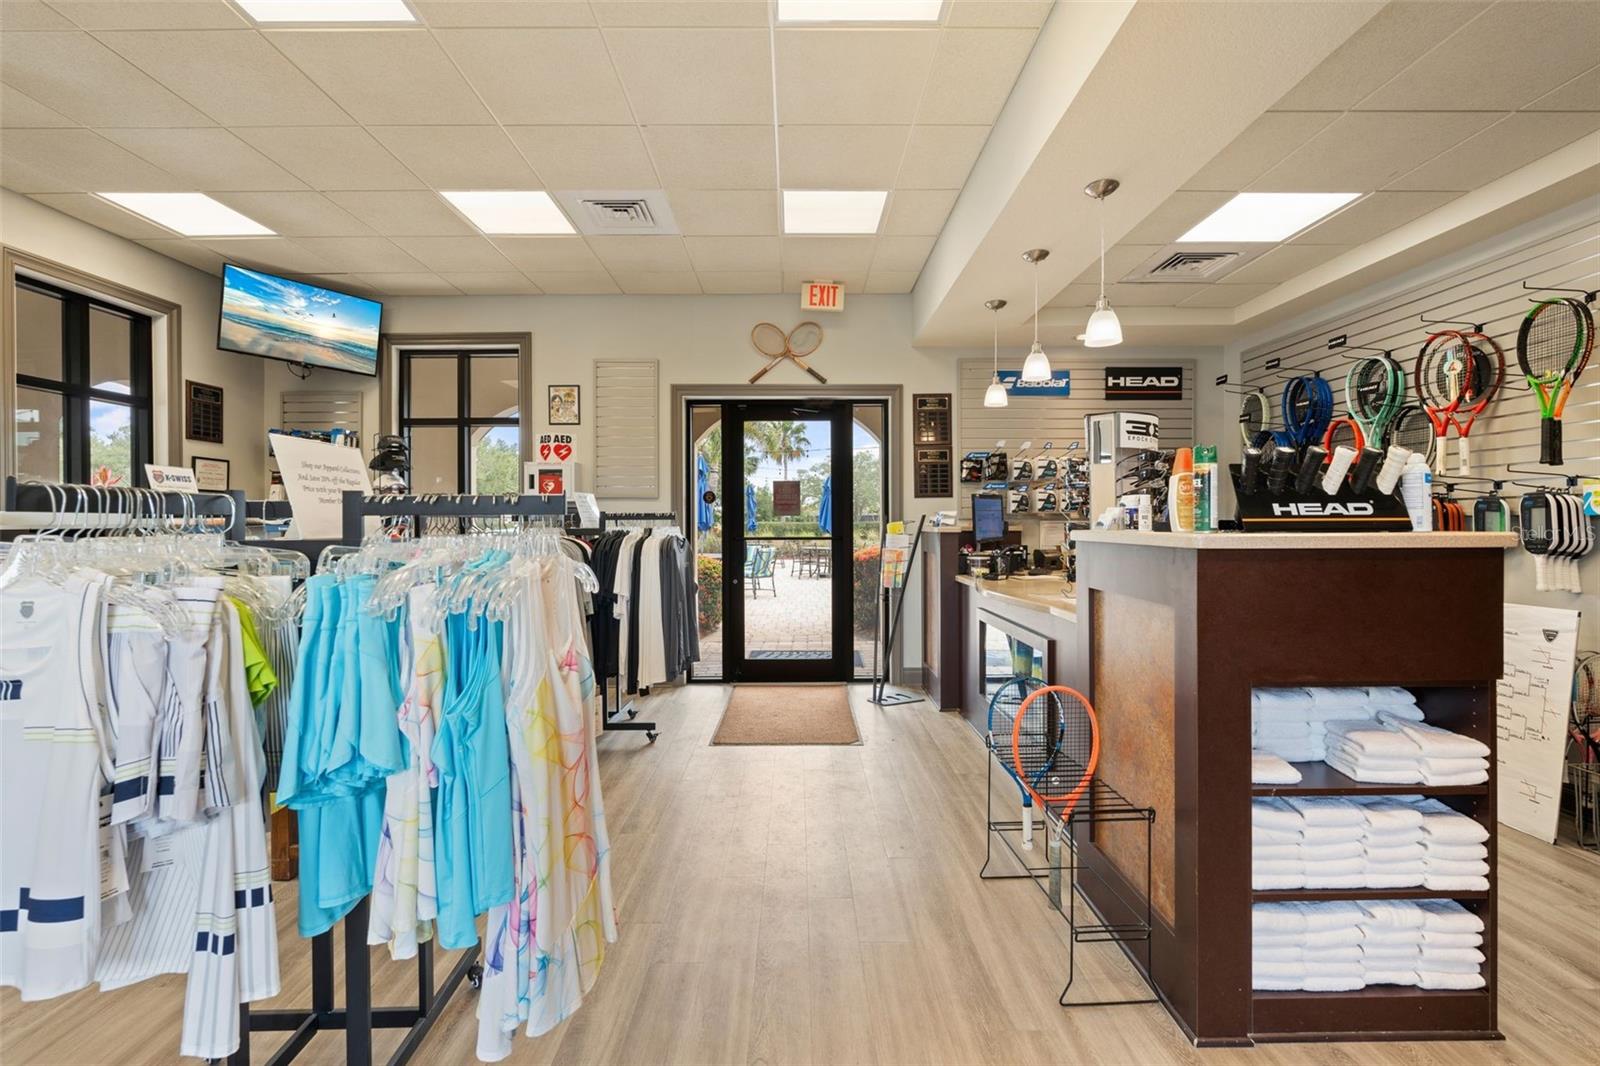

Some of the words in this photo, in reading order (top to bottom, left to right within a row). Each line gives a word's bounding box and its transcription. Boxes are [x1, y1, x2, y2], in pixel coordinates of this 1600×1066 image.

[809, 285, 838, 306] EXIT
[1107, 376, 1179, 387] HEAD
[540, 435, 551, 443] AED
[553, 435, 572, 443] AED
[165, 474, 192, 483] K-SWISS
[1272, 502, 1374, 516] HEAD
